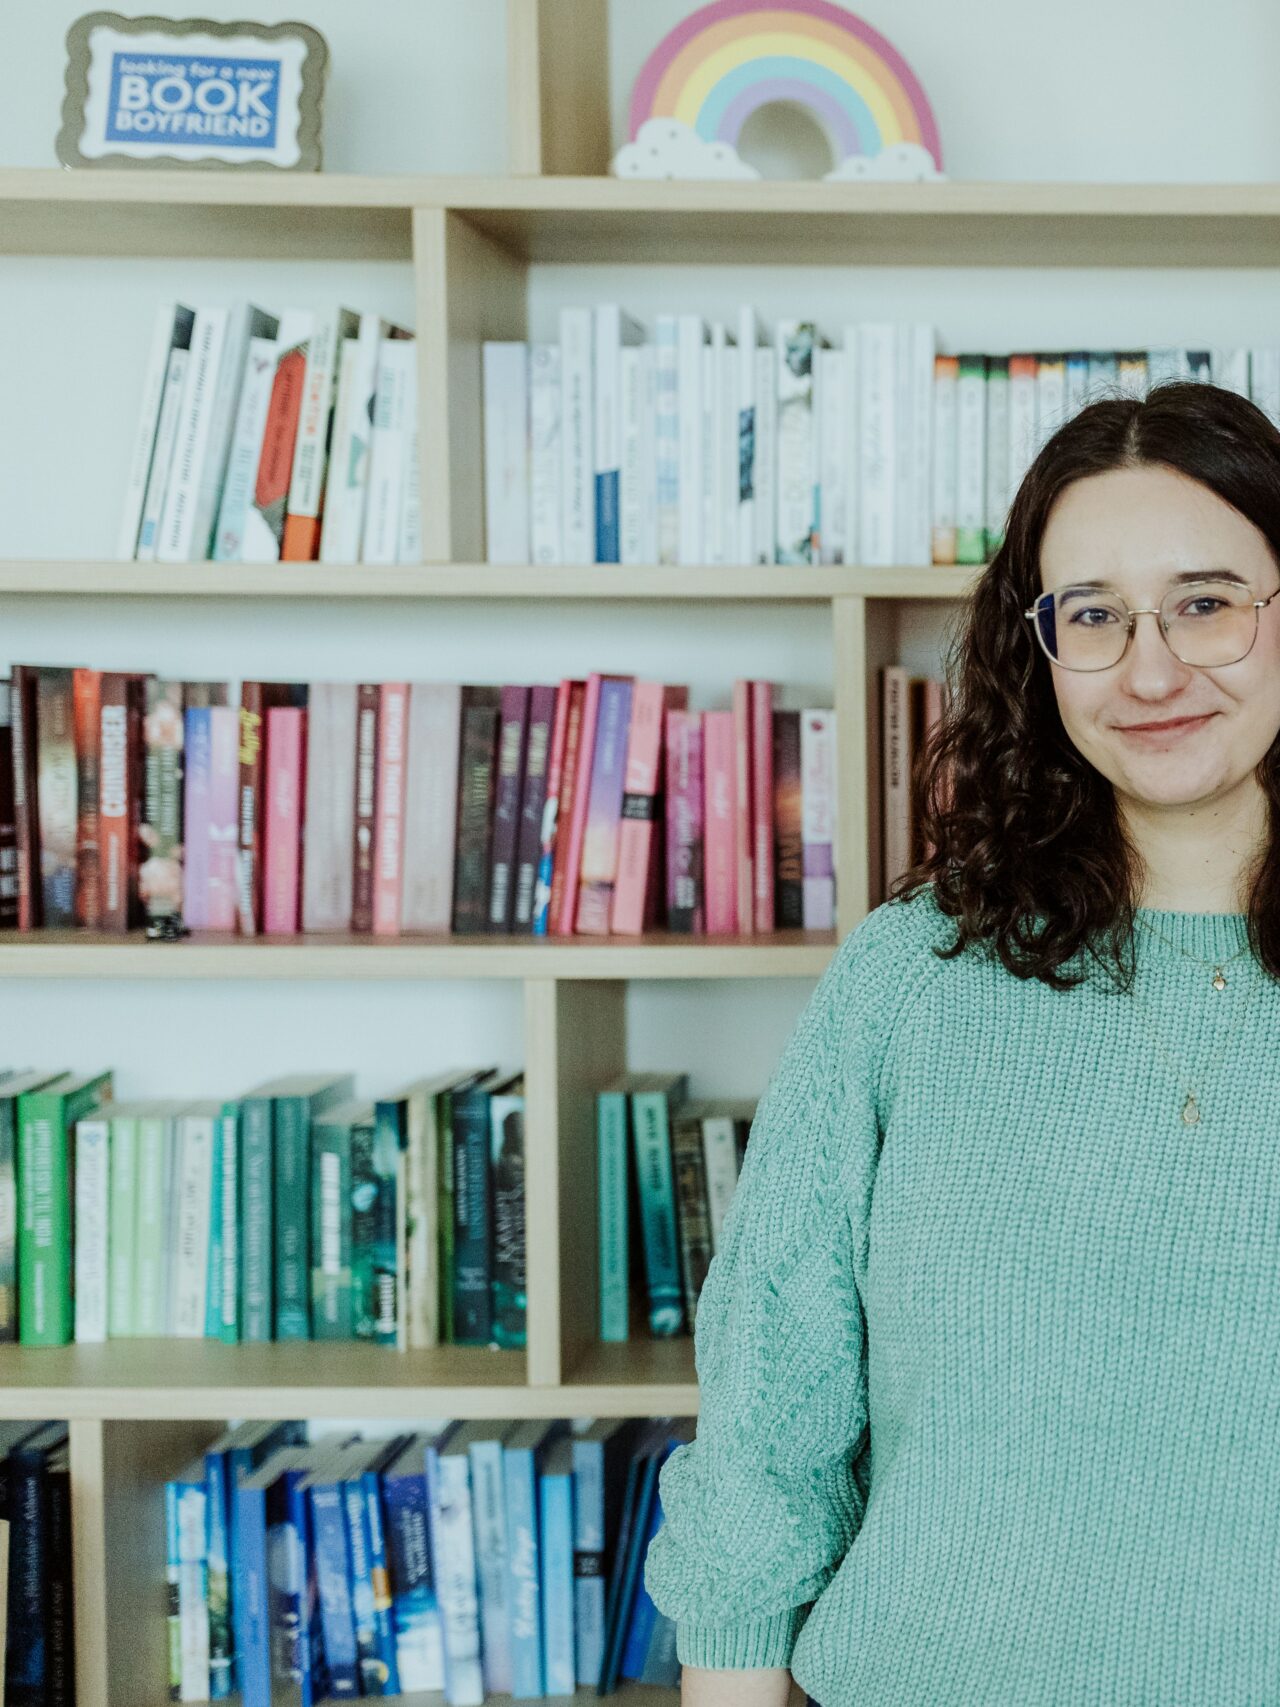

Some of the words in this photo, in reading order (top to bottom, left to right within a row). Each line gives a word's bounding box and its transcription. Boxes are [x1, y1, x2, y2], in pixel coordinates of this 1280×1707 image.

[119, 57, 186, 78] looking
[190, 61, 216, 78] for
[219, 66, 234, 80] a
[235, 67, 275, 82] new
[119, 74, 273, 117] BOOK
[115, 111, 270, 138] BOYFRIEND
